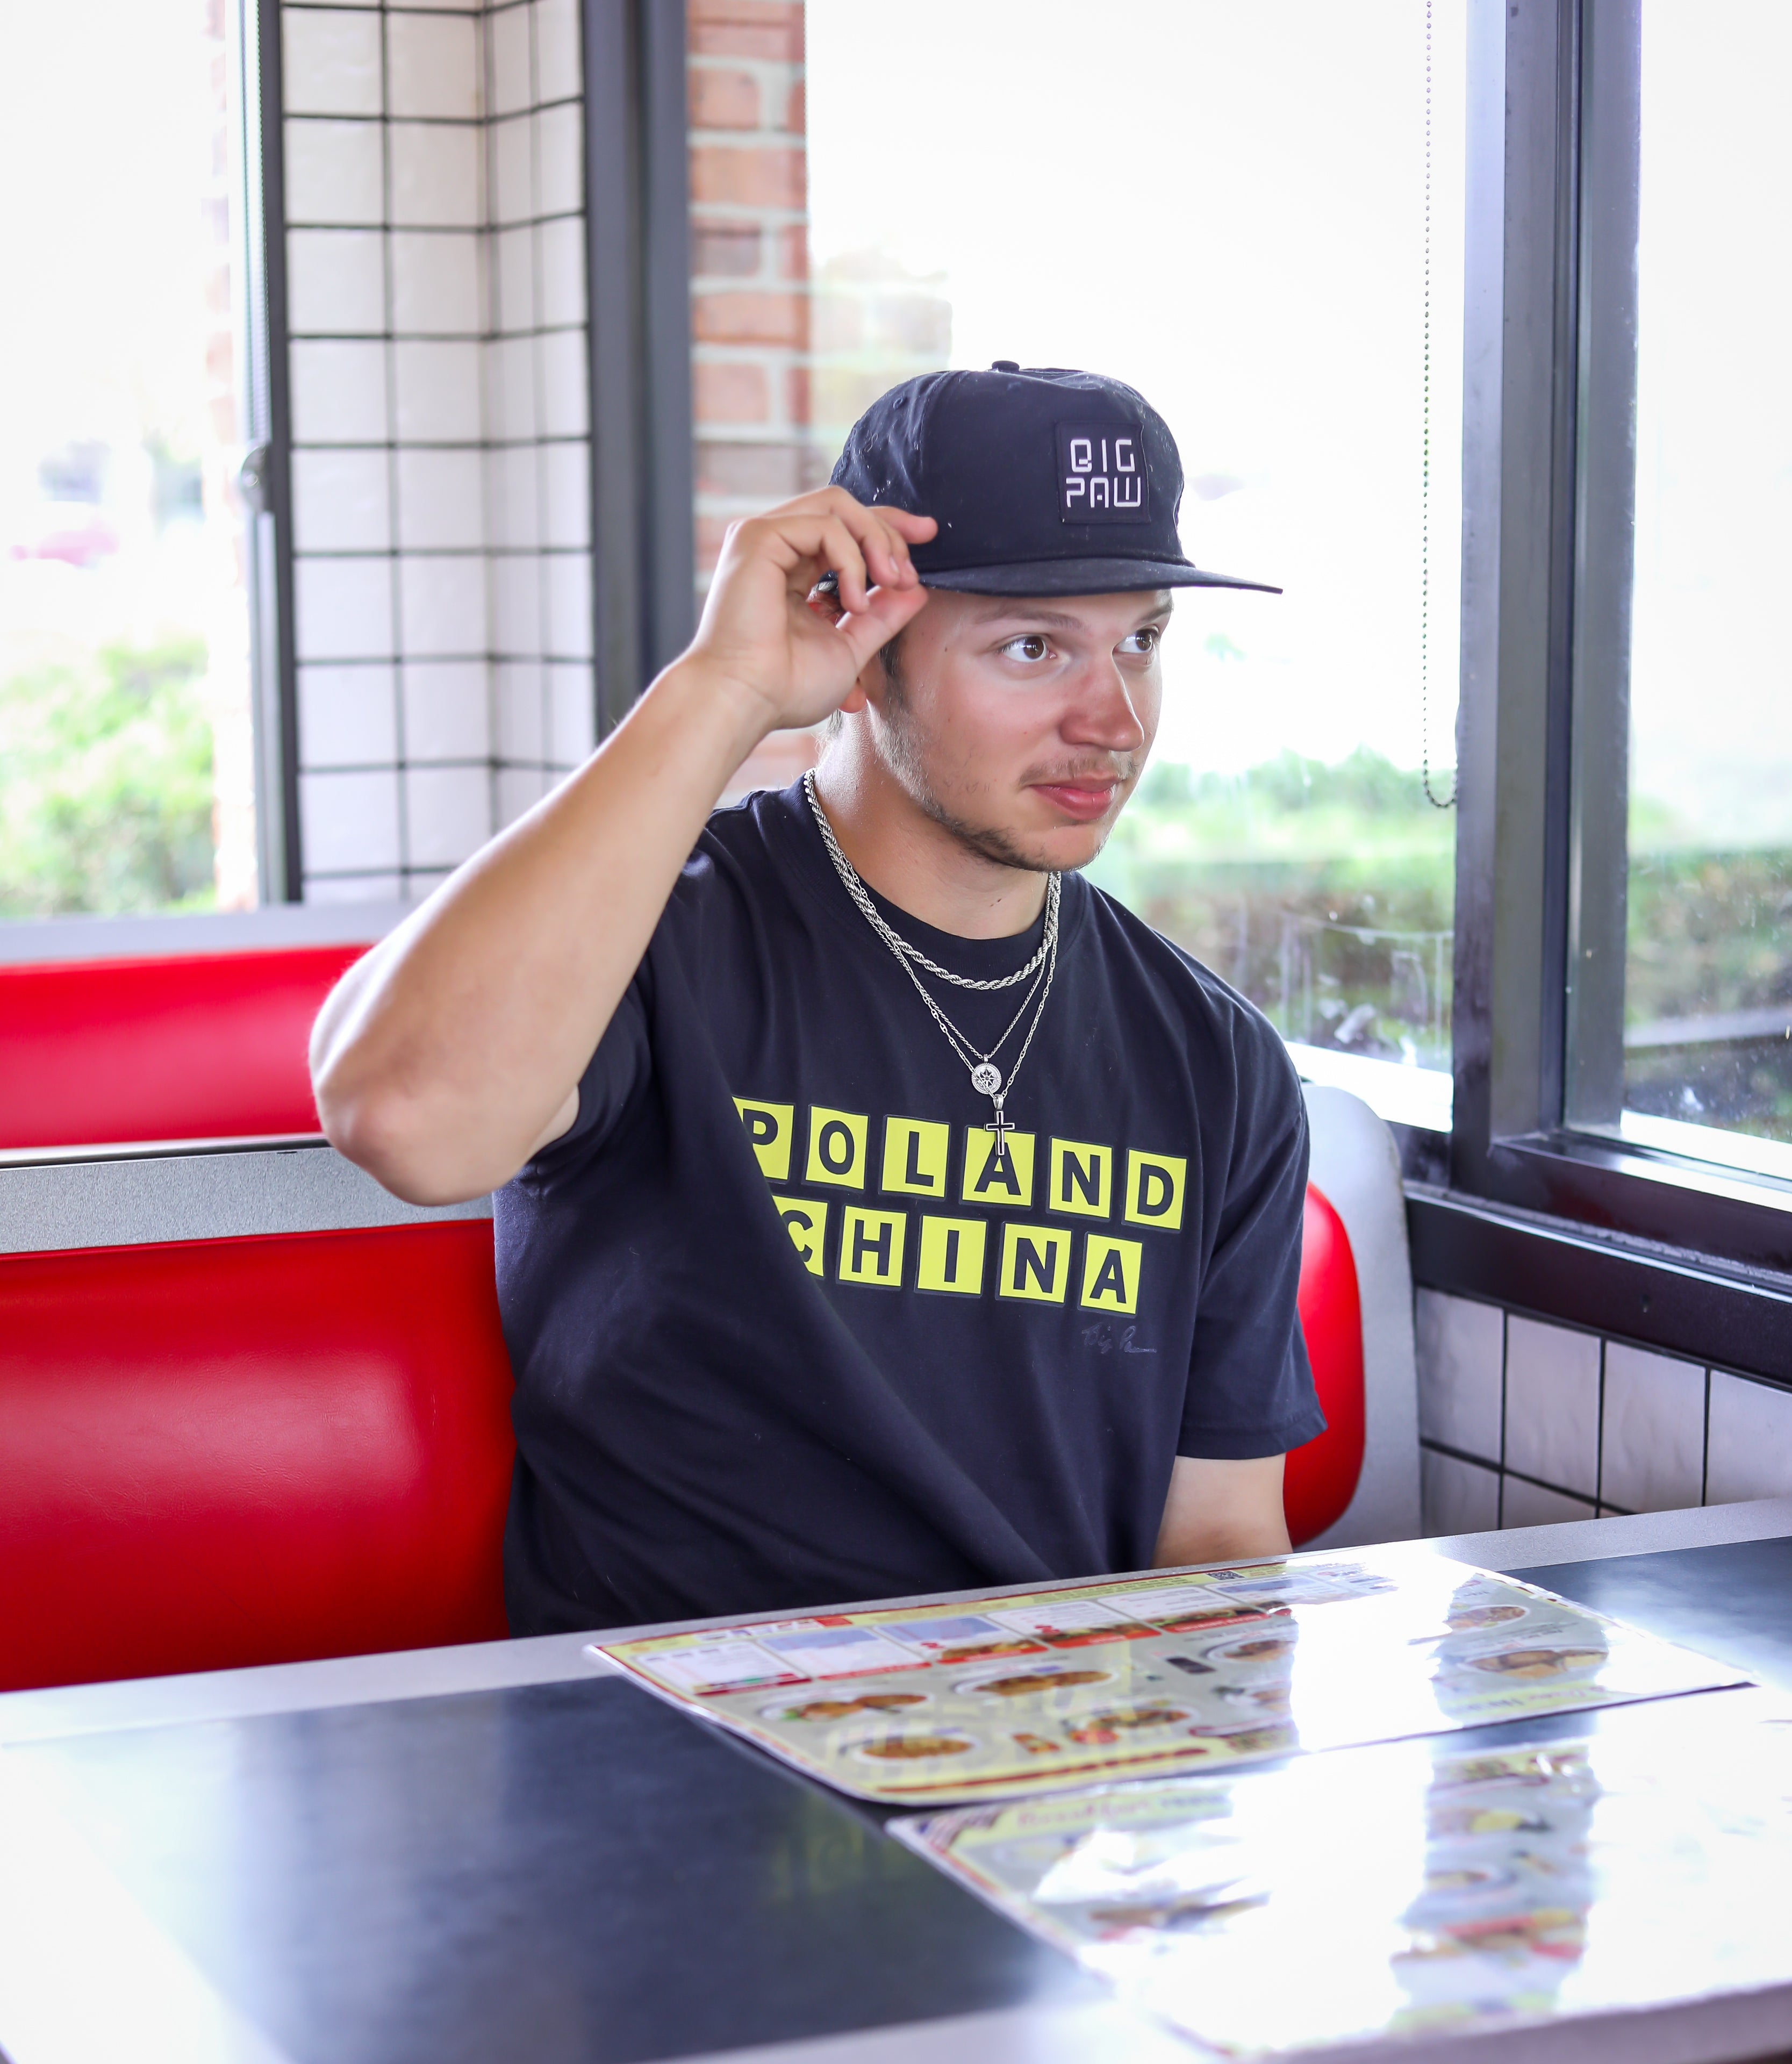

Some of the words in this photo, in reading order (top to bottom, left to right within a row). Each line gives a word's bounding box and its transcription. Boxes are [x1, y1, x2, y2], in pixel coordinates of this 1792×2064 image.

[1066, 477, 1141, 508] PAW
[741, 1108, 1174, 1216] POLAND
[782, 1210, 1127, 1305] CHINA
